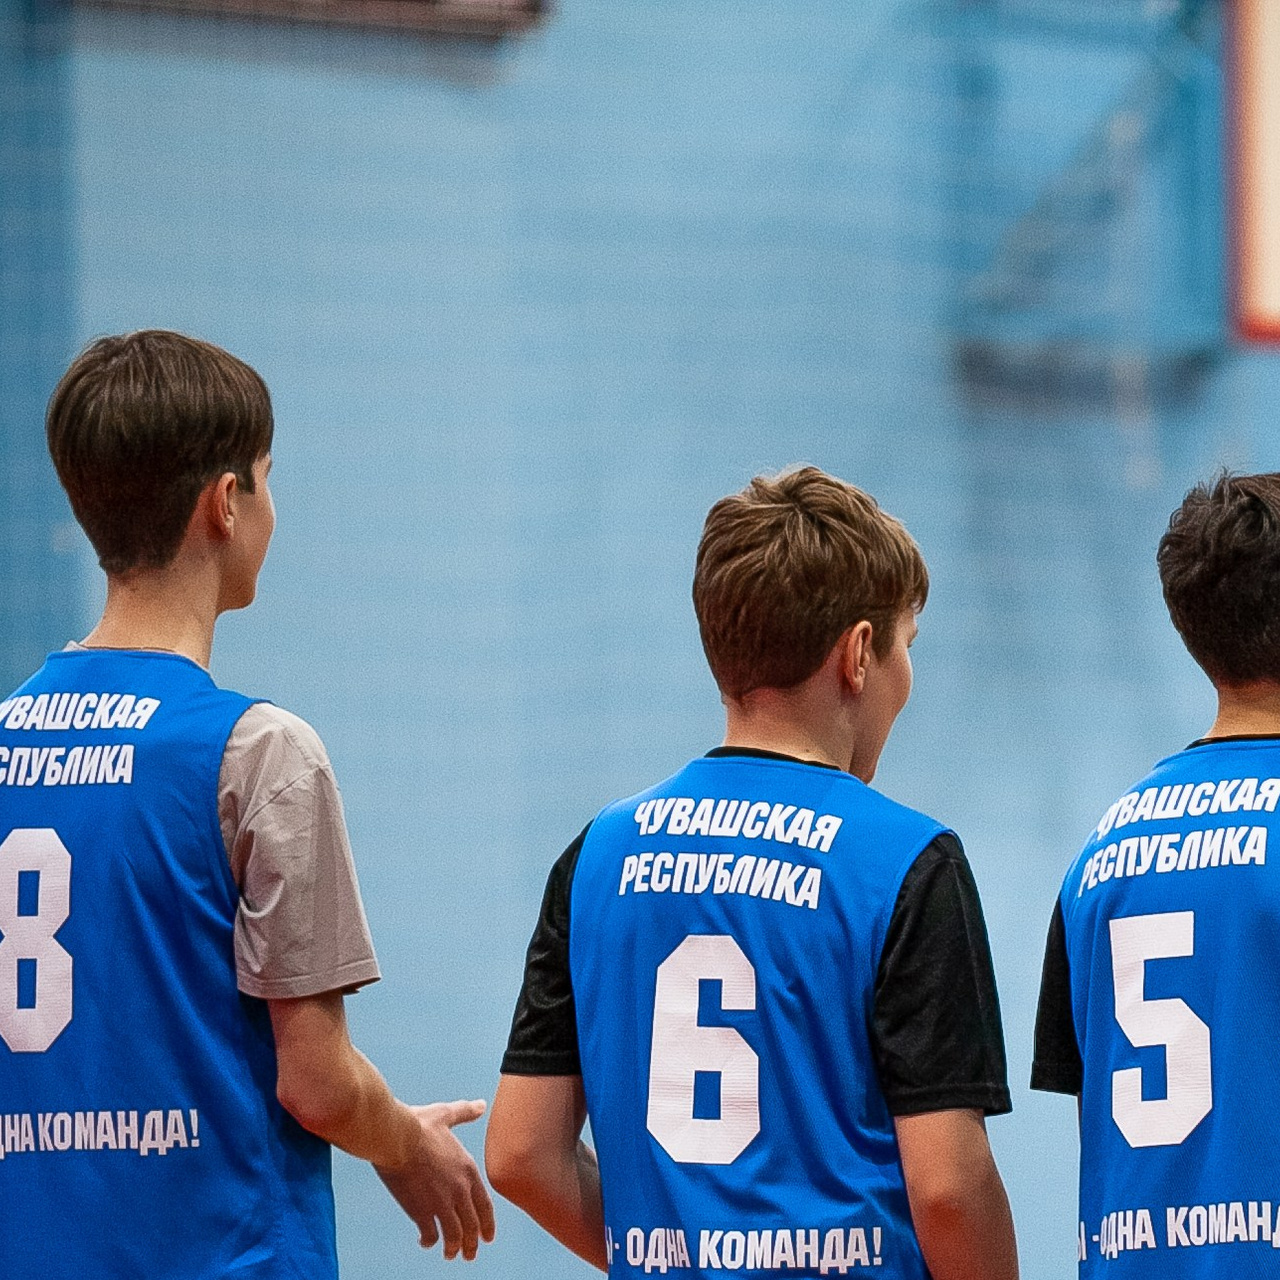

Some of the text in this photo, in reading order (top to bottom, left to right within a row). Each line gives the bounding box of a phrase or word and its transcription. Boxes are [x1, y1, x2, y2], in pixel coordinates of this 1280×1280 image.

[633, 797, 843, 853] ЧУВАШСКАЯ
[618, 852, 823, 910] РЕСПУБЛИКА
[1077, 826, 1268, 898] РЕСПУБЛИКА
[0, 827, 73, 1053] 8
[646, 934, 761, 1165] 6
[1108, 910, 1213, 1149] 5
[0, 1109, 200, 1160] НА КОМАНДА!
[626, 1227, 691, 1274] ОДНА
[698, 1226, 882, 1275] КОМАНДА!
